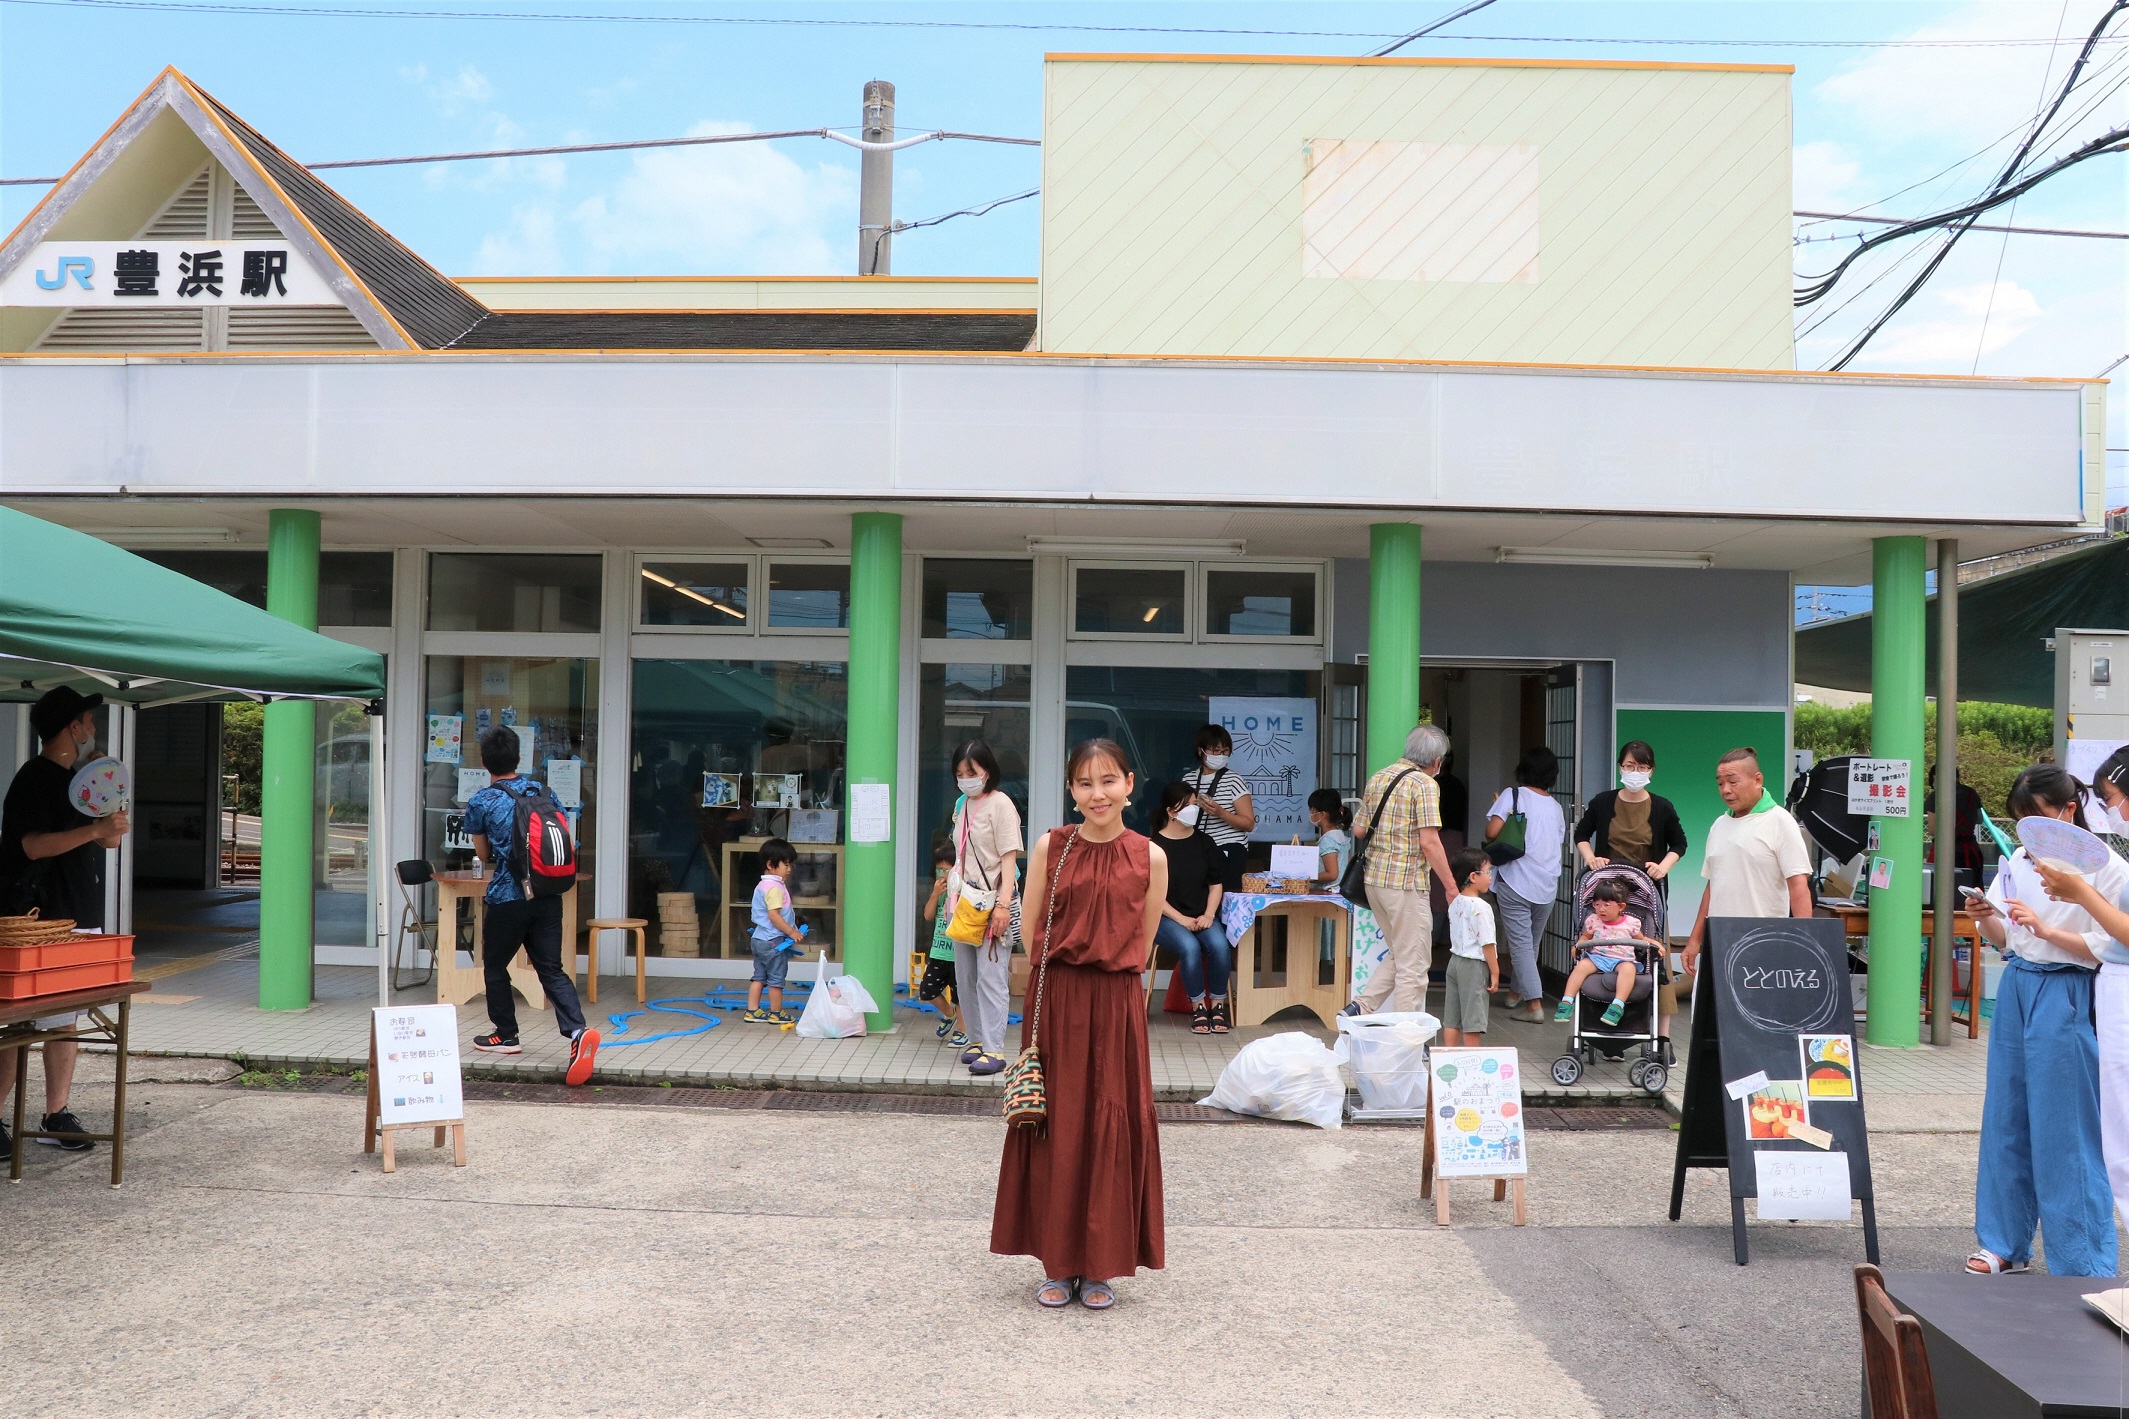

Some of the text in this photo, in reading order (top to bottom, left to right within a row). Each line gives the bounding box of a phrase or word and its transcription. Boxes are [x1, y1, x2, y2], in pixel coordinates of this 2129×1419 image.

[36, 250, 288, 299] JR 豊浜駅
[1221, 715, 1304, 732] HOME
[1869, 784, 1906, 798] 撮影会
[1885, 806, 1907, 815] 500円
[1254, 814, 1302, 824] OHAMA
[1742, 966, 1820, 989] ととのえる
[398, 1075, 420, 1083] アイス
